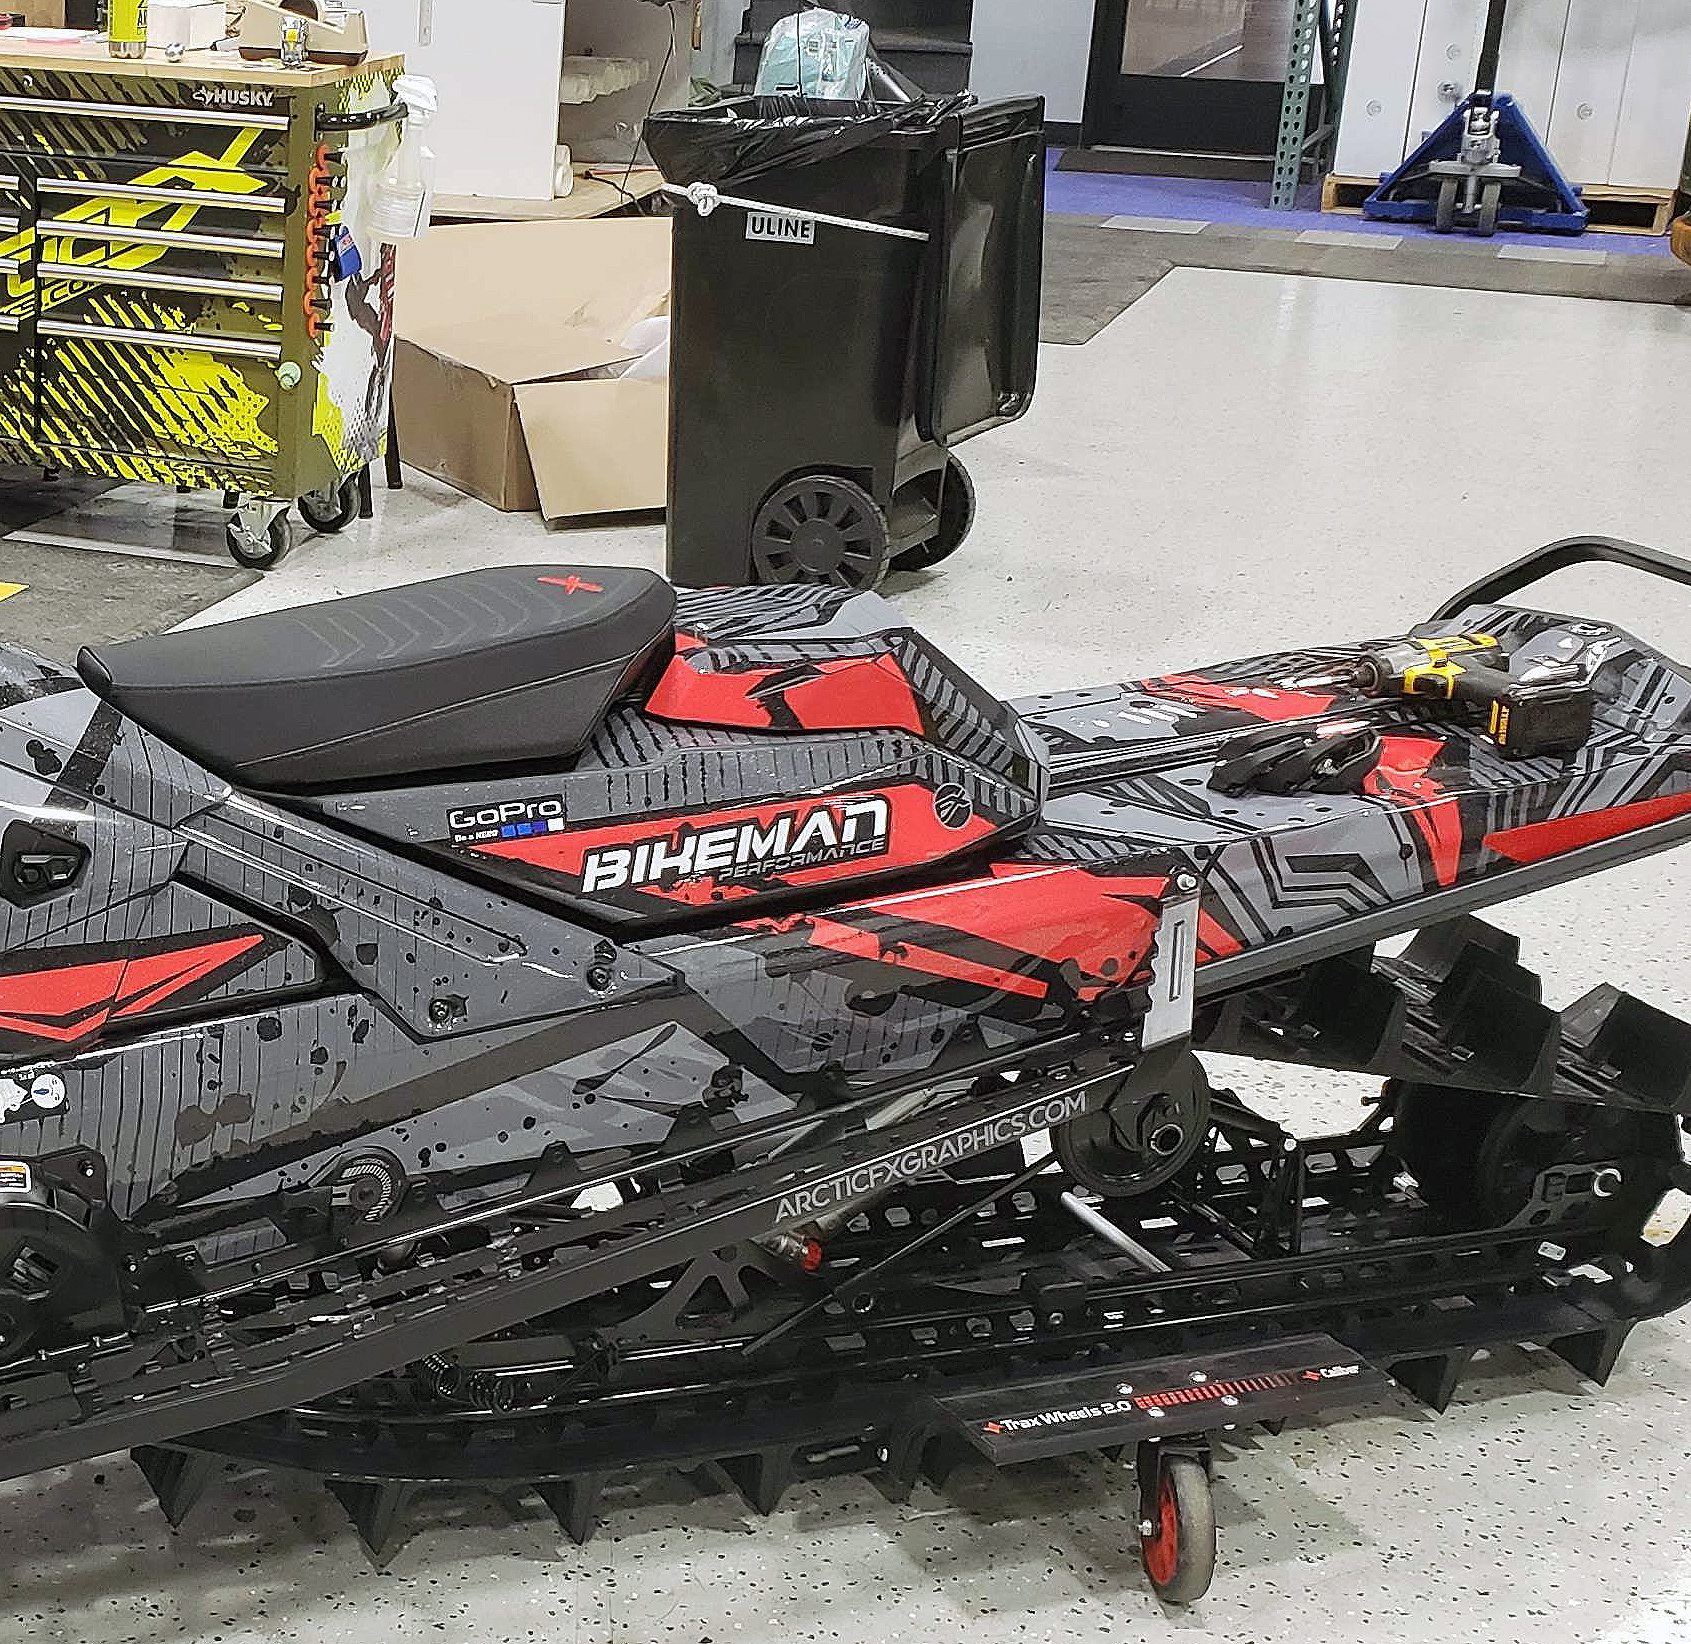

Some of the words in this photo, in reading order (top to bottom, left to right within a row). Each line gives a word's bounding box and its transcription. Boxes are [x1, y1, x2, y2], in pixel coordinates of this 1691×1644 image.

[213, 89, 274, 107] HUSKY
[751, 216, 811, 239] ULINE
[448, 800, 561, 829] GoPro
[581, 798, 888, 894] BIKEMAN
[717, 837, 886, 882] PERFORMANCE
[774, 1090, 1087, 1224] ARCTICFXGRAPHICS.COM
[1000, 1414, 1039, 1433] Trax
[1038, 1403, 1102, 1427] Wheels
[1102, 1400, 1133, 1415] 2.0
